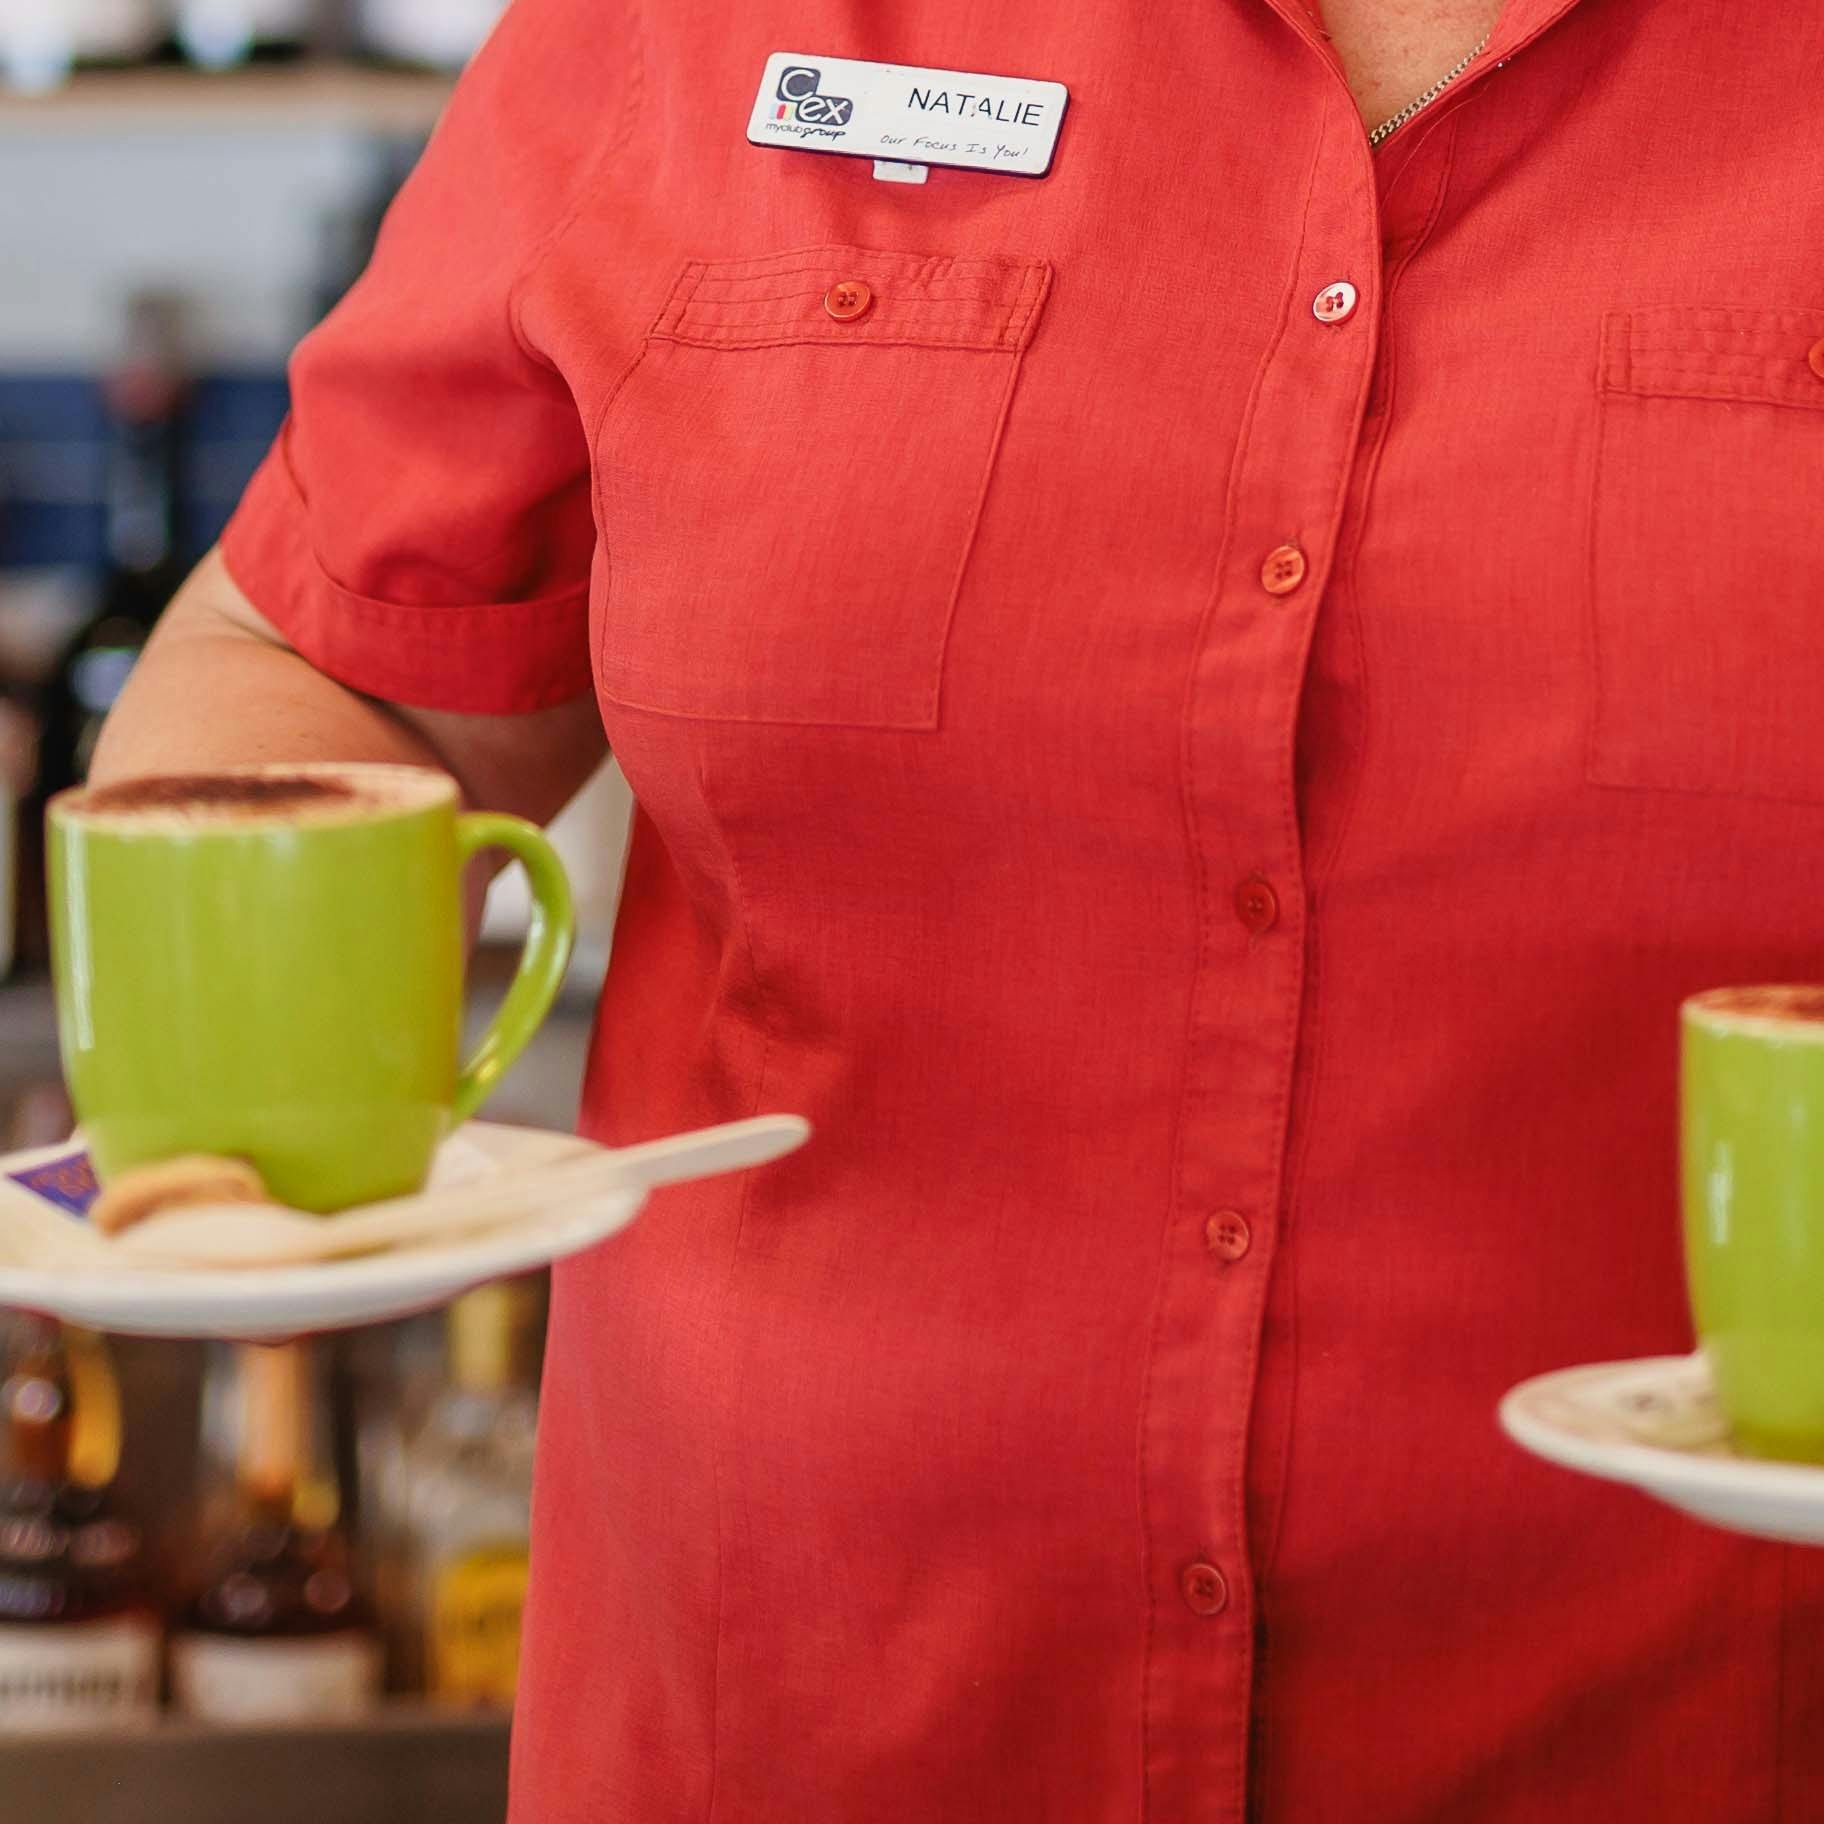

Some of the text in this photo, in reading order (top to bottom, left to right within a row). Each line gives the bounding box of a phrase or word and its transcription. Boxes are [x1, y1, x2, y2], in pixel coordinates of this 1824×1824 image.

[907, 87, 1044, 127] NATALIE
[879, 134, 1029, 160] Our Focus Is You!
